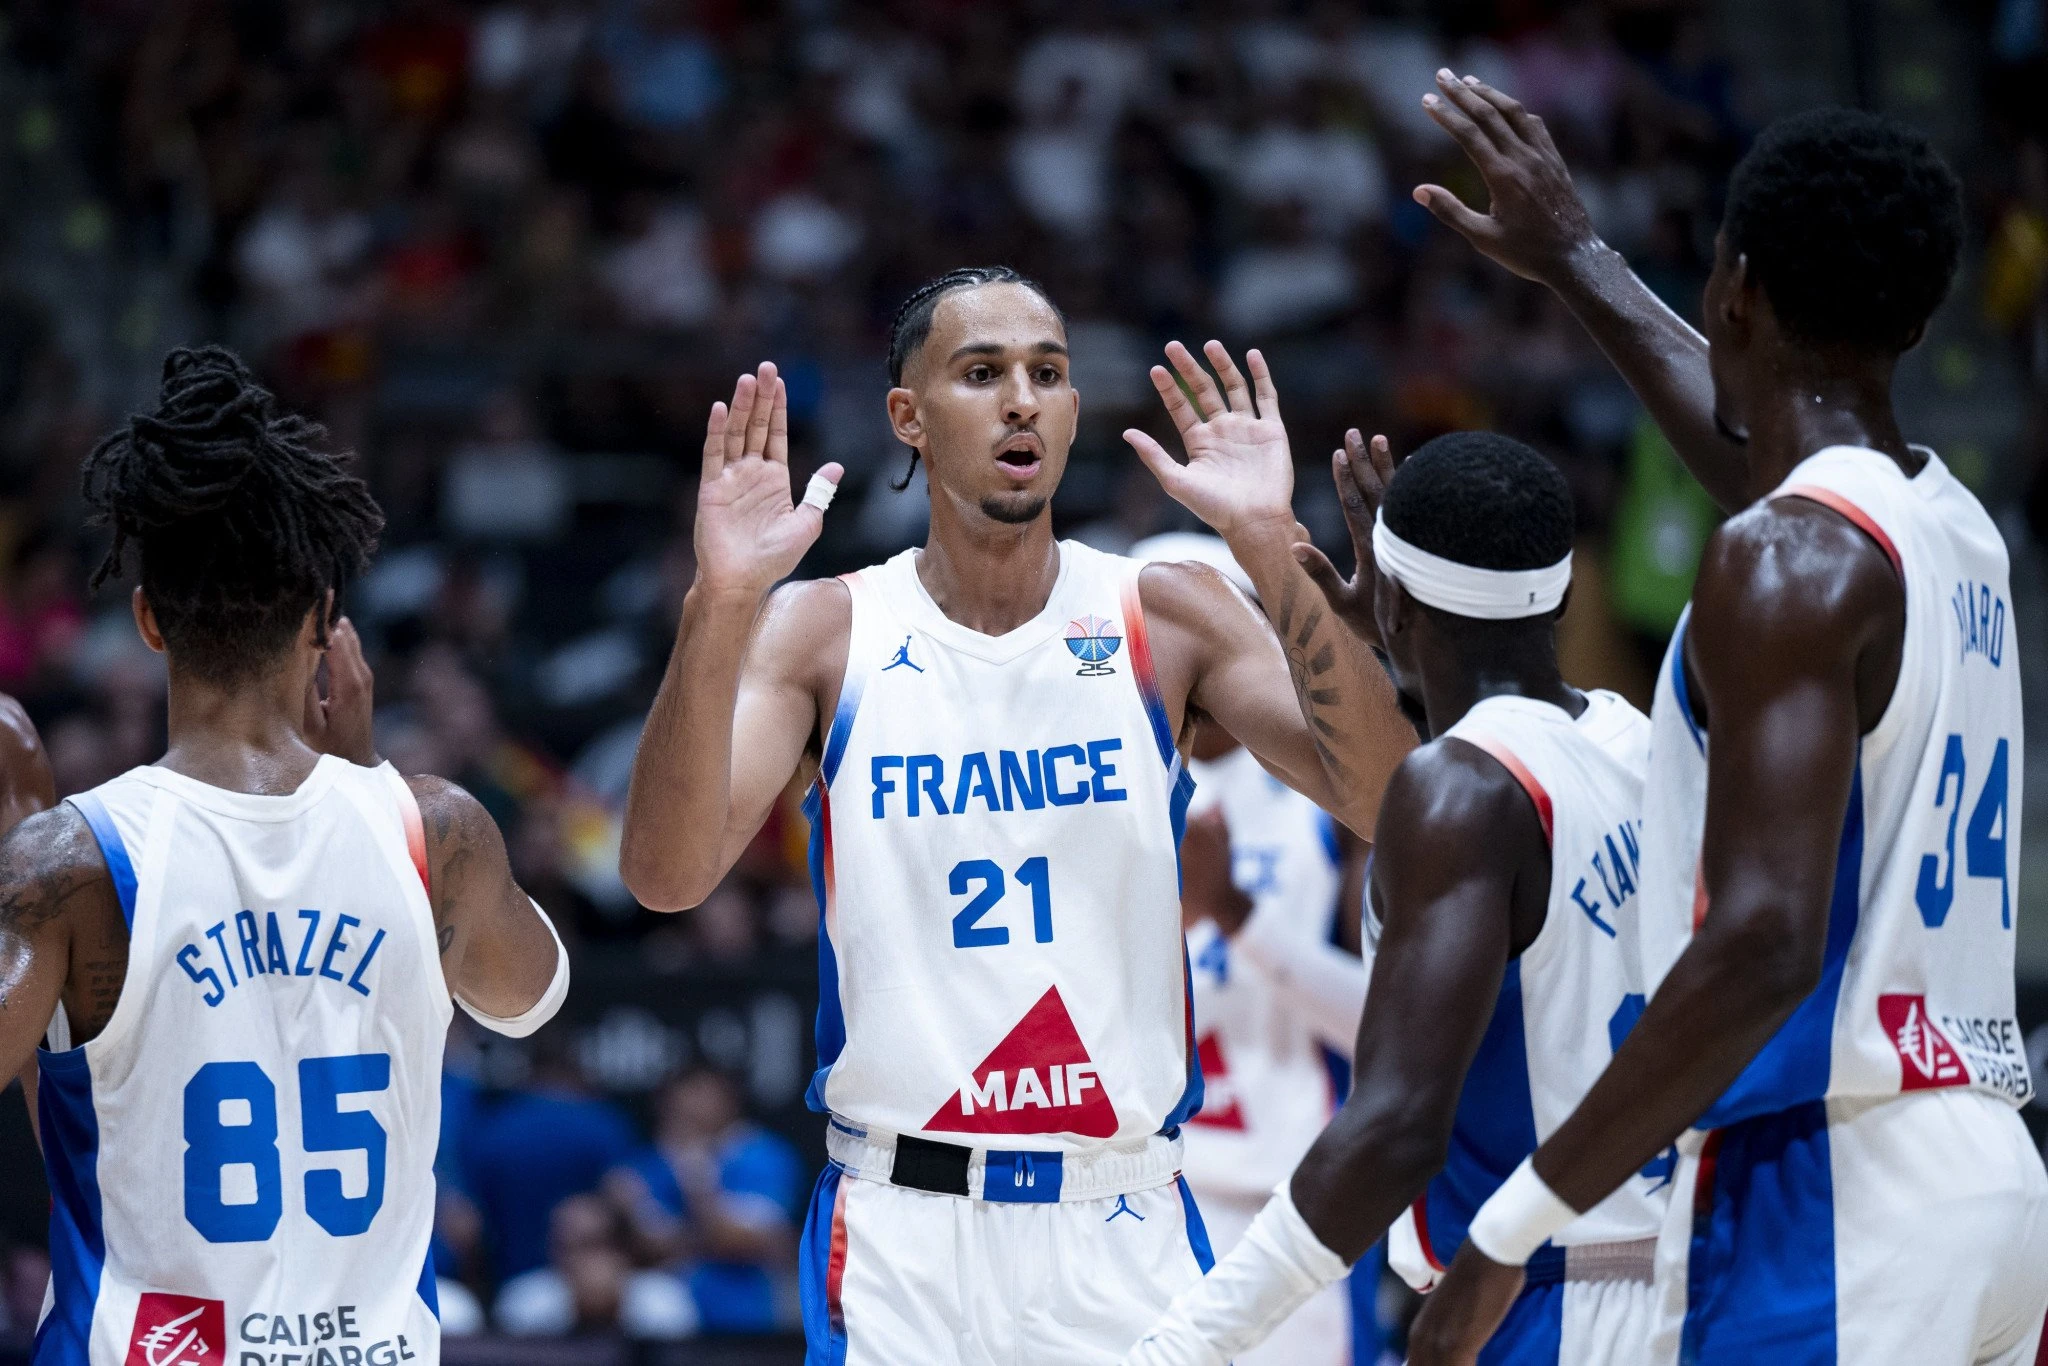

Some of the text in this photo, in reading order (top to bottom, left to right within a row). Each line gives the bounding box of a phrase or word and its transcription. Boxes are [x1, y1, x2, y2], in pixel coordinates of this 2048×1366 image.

[870, 737, 1128, 820] FRANCE
[1914, 733, 2012, 930] 34
[947, 855, 1054, 950] 21
[175, 908, 386, 1008] STRAZEL
[958, 1061, 1097, 1116] MAIF
[182, 1052, 392, 1244] 85
